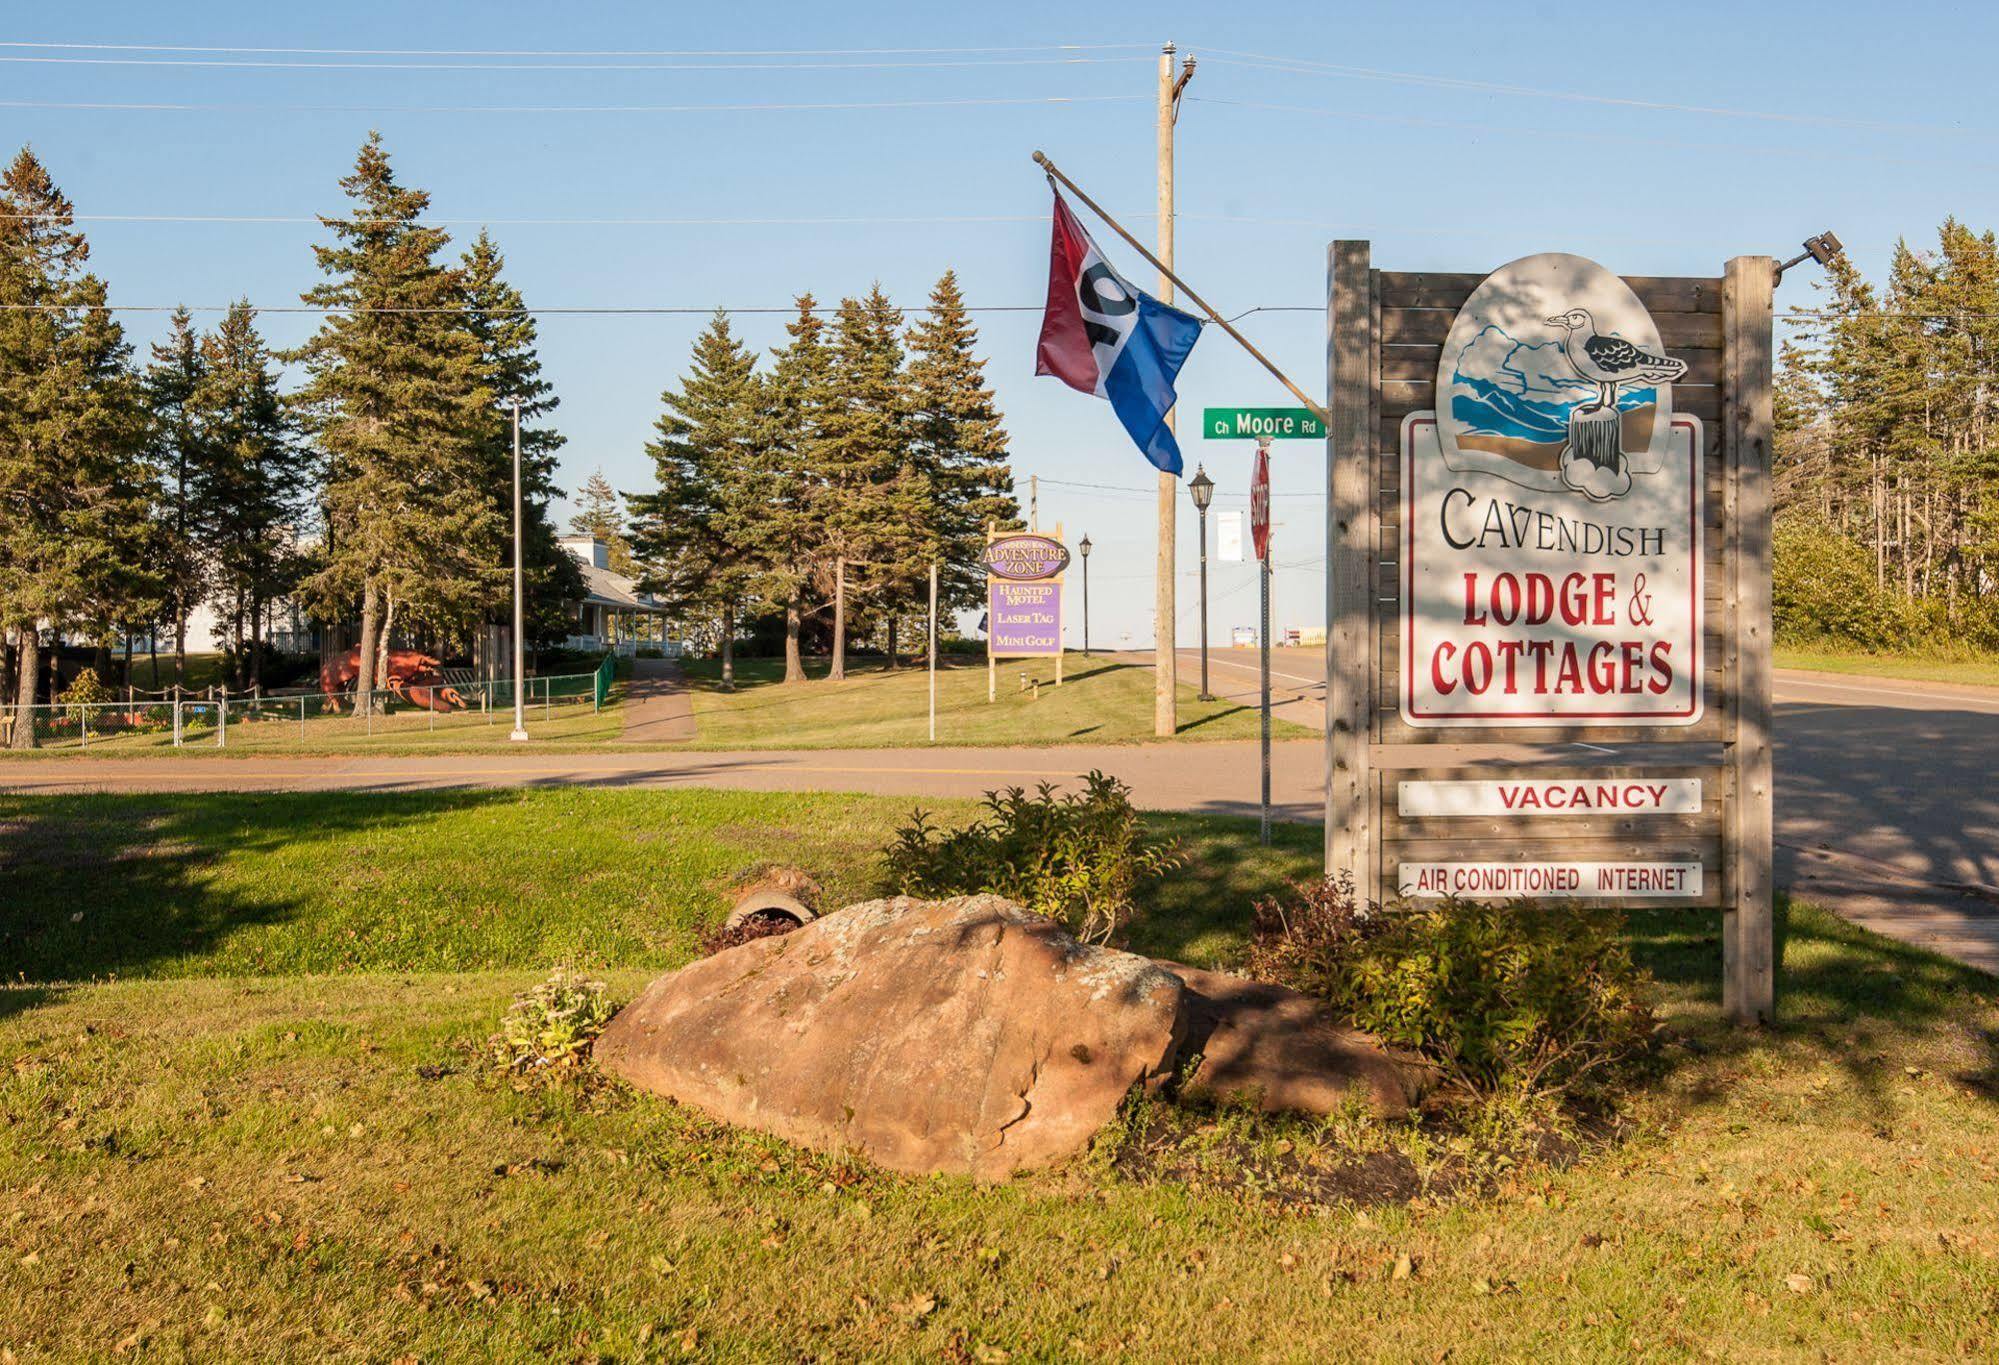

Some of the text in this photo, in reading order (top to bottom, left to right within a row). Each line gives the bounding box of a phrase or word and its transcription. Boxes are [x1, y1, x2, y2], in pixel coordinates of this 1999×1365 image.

[1215, 413, 1317, 434] Ch Moore Rd
[1251, 484, 1269, 526] STOP
[1440, 487, 1667, 556] CAVENDISH
[982, 547, 1067, 563] ADVENTURE
[1006, 561, 1045, 575] ZONE
[999, 585, 1053, 596] HAUNTED
[1006, 595, 1046, 606] MOTEL
[1463, 571, 1654, 627] LODGE &
[997, 612, 1054, 624] LASER TAG
[996, 635, 1056, 646] MINI GOLF
[1431, 640, 1674, 696] COTTAGES
[1498, 785, 1669, 809] VACANCY
[1417, 868, 1687, 891] AIR CONDITIONED INTERNET
